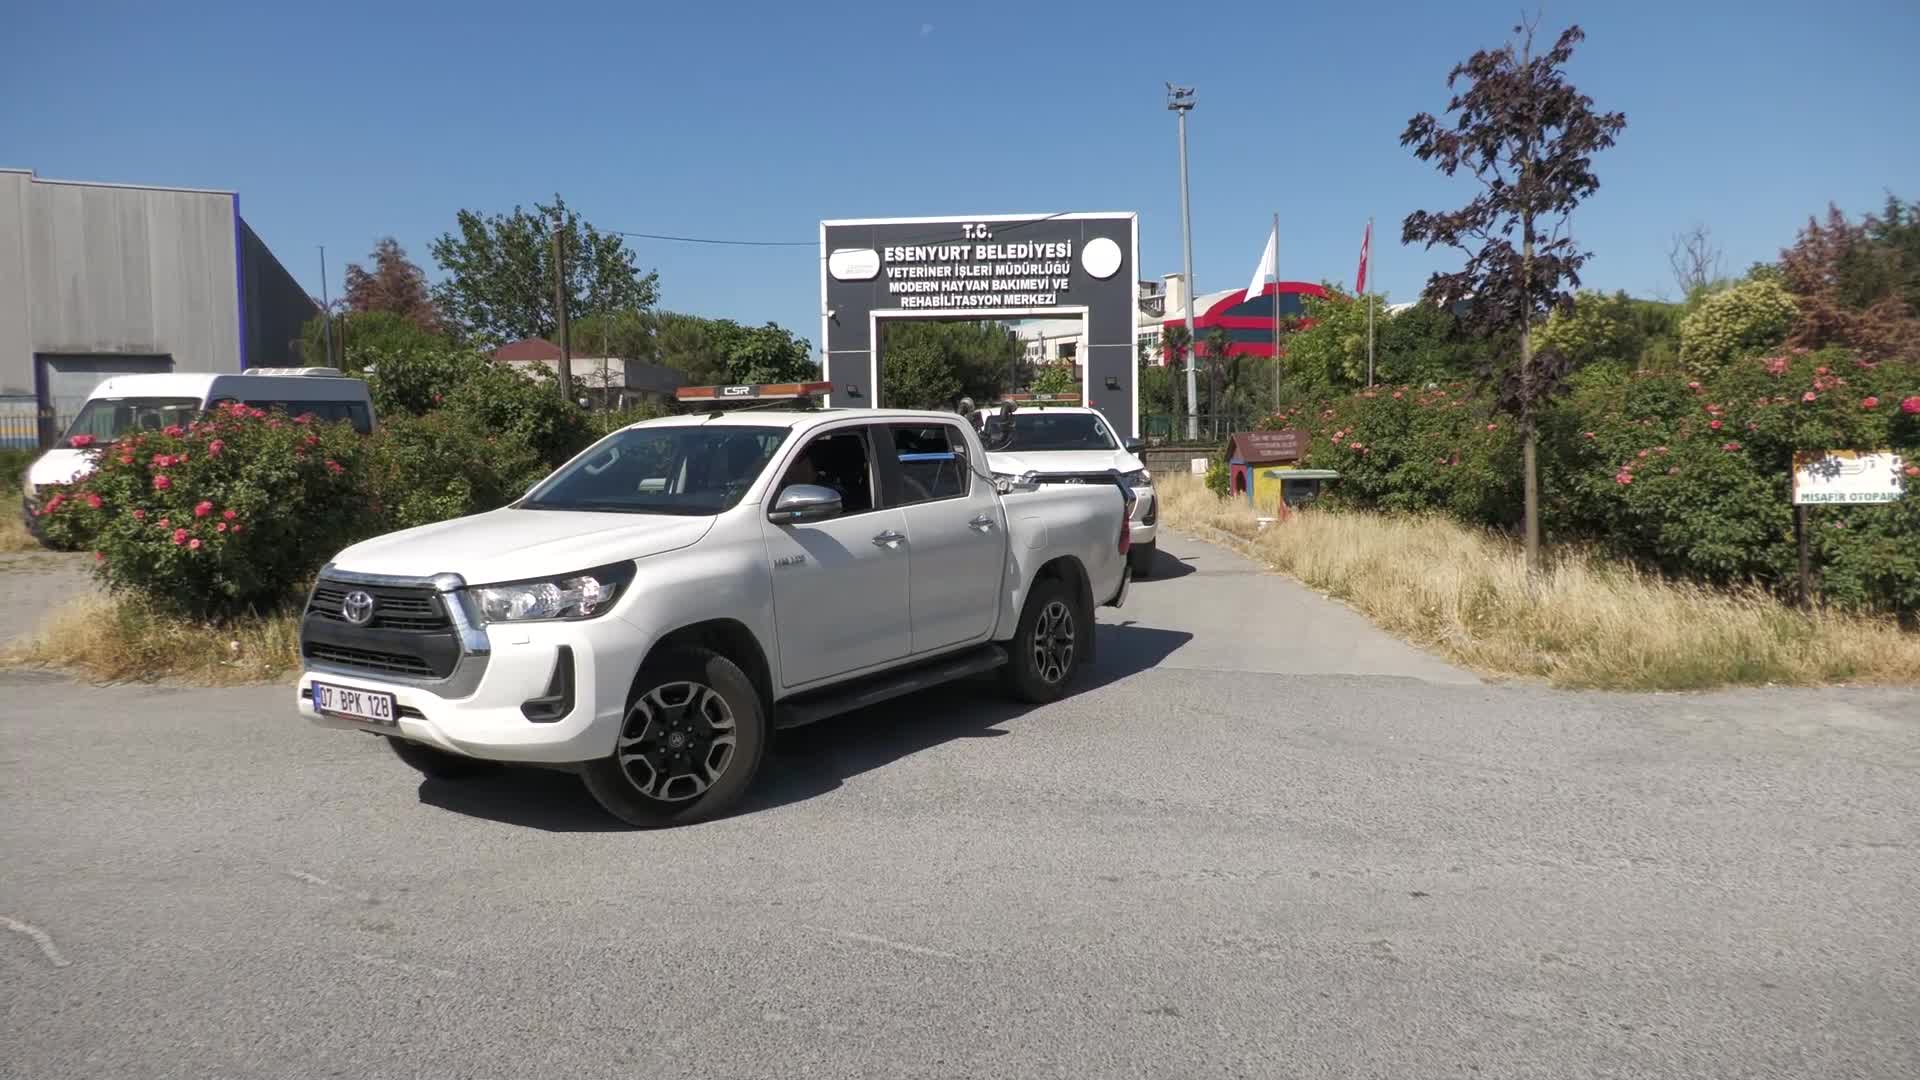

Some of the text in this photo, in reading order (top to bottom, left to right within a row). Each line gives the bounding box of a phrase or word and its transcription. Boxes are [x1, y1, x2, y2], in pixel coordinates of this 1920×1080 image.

[962, 223, 993, 239] T.C.
[884, 239, 1072, 262] ESENYURT BELEDİYESİ
[886, 263, 952, 278] VETERİNER
[955, 262, 993, 278] İŞLERİ
[995, 260, 1070, 276] MÜDÜRLÜĞÜ
[889, 275, 1069, 293] MODERN HAYVAN BAKIMEVİ VE
[900, 291, 1057, 308] REHABİLİTASYON MERKEZİ
[723, 386, 750, 396] CSR
[320, 686, 390, 718] 07 BPK 128
